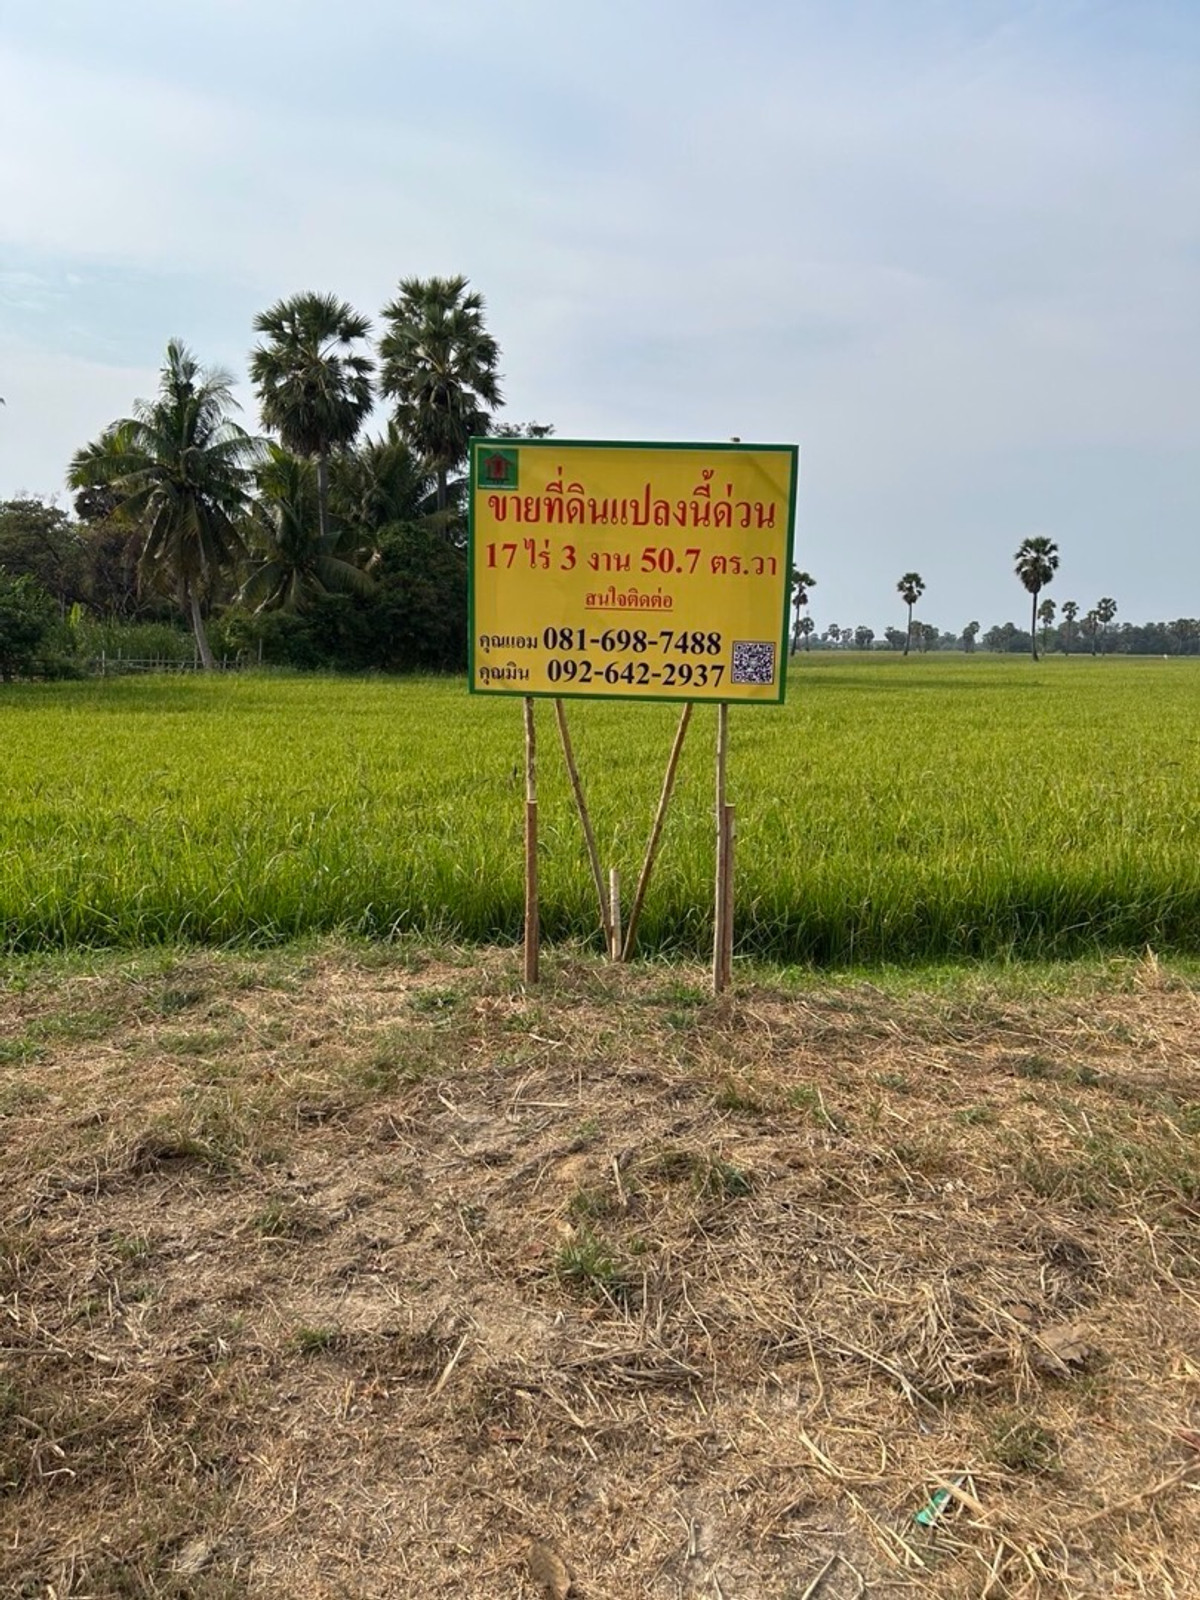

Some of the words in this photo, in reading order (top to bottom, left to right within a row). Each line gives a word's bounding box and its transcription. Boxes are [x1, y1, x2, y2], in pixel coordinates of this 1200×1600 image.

[488, 466, 776, 528] ขายที่ดินแปลงนี้ด่วน
[486, 543, 518, 569] 17
[523, 538, 550, 570] ไร่
[560, 545, 577, 571] 3
[587, 552, 631, 572] งาน
[641, 547, 701, 574] 50.7
[711, 553, 777, 576] ตร.วา
[585, 586, 673, 609] สนใจติดต่อ
[479, 633, 538, 654] คุณแอม
[543, 626, 722, 655] 081-698-7488
[479, 661, 529, 686] คุณมิน
[547, 659, 726, 687] 092-642-2937
